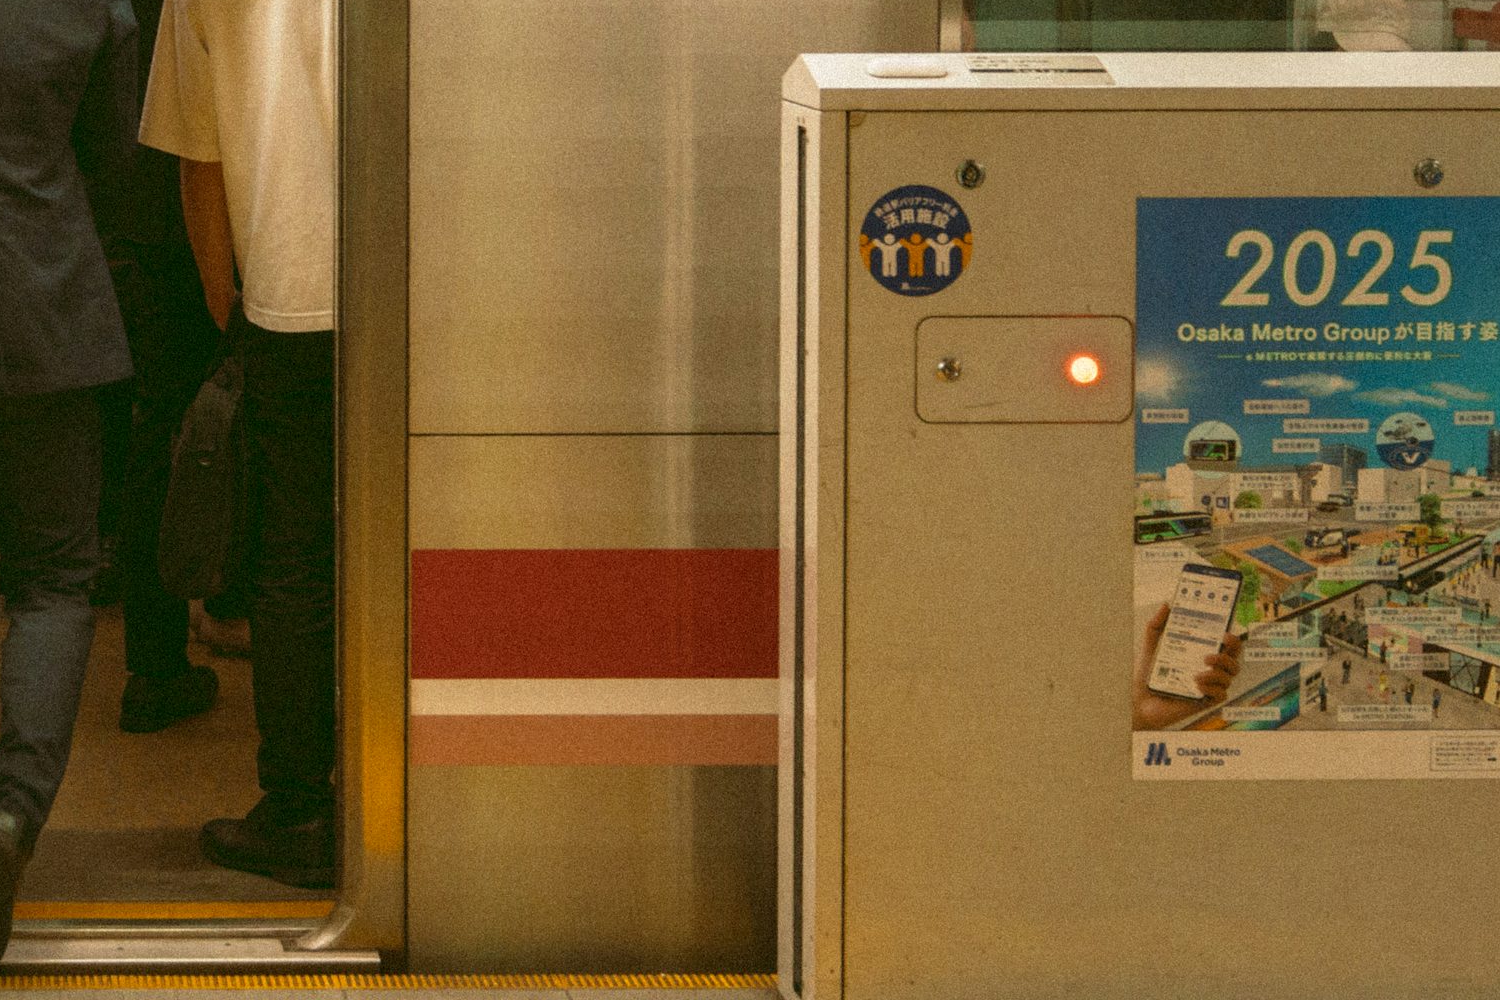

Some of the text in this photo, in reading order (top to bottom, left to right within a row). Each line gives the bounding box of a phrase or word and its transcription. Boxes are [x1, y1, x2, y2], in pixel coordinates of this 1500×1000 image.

[1220, 230, 1453, 306] 2025
[1177, 321, 1498, 345] Osaka Metro Group が目指す姿
[1177, 748, 1241, 757] Osaka Metro
[1192, 758, 1224, 767] Group
